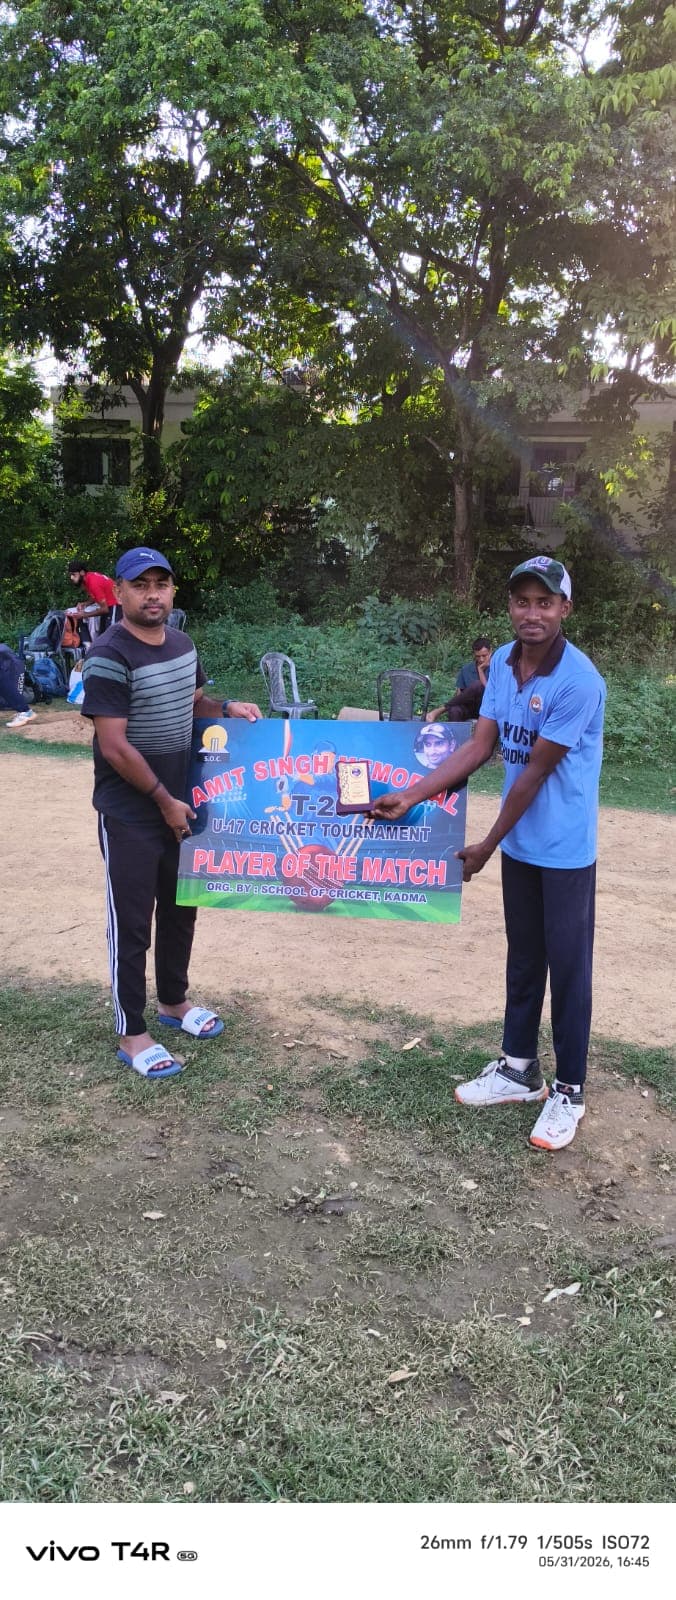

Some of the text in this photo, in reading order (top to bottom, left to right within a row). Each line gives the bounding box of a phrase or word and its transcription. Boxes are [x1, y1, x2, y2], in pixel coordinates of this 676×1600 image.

[192, 767, 246, 808] AMIT
[253, 755, 330, 781] SINGH
[291, 794, 350, 818] T-2
[212, 818, 432, 842] U-17 CRICKET TOURNAMENT
[192, 849, 447, 886] PLAYER OF THE MATCH
[207, 882, 232, 893] ORG.
[236, 883, 252, 894] BY
[261, 885, 307, 897] SCHOOL
[310, 887, 326, 898] OF
[328, 888, 381, 902] CRICKET,
[384, 891, 428, 904] KADMA
